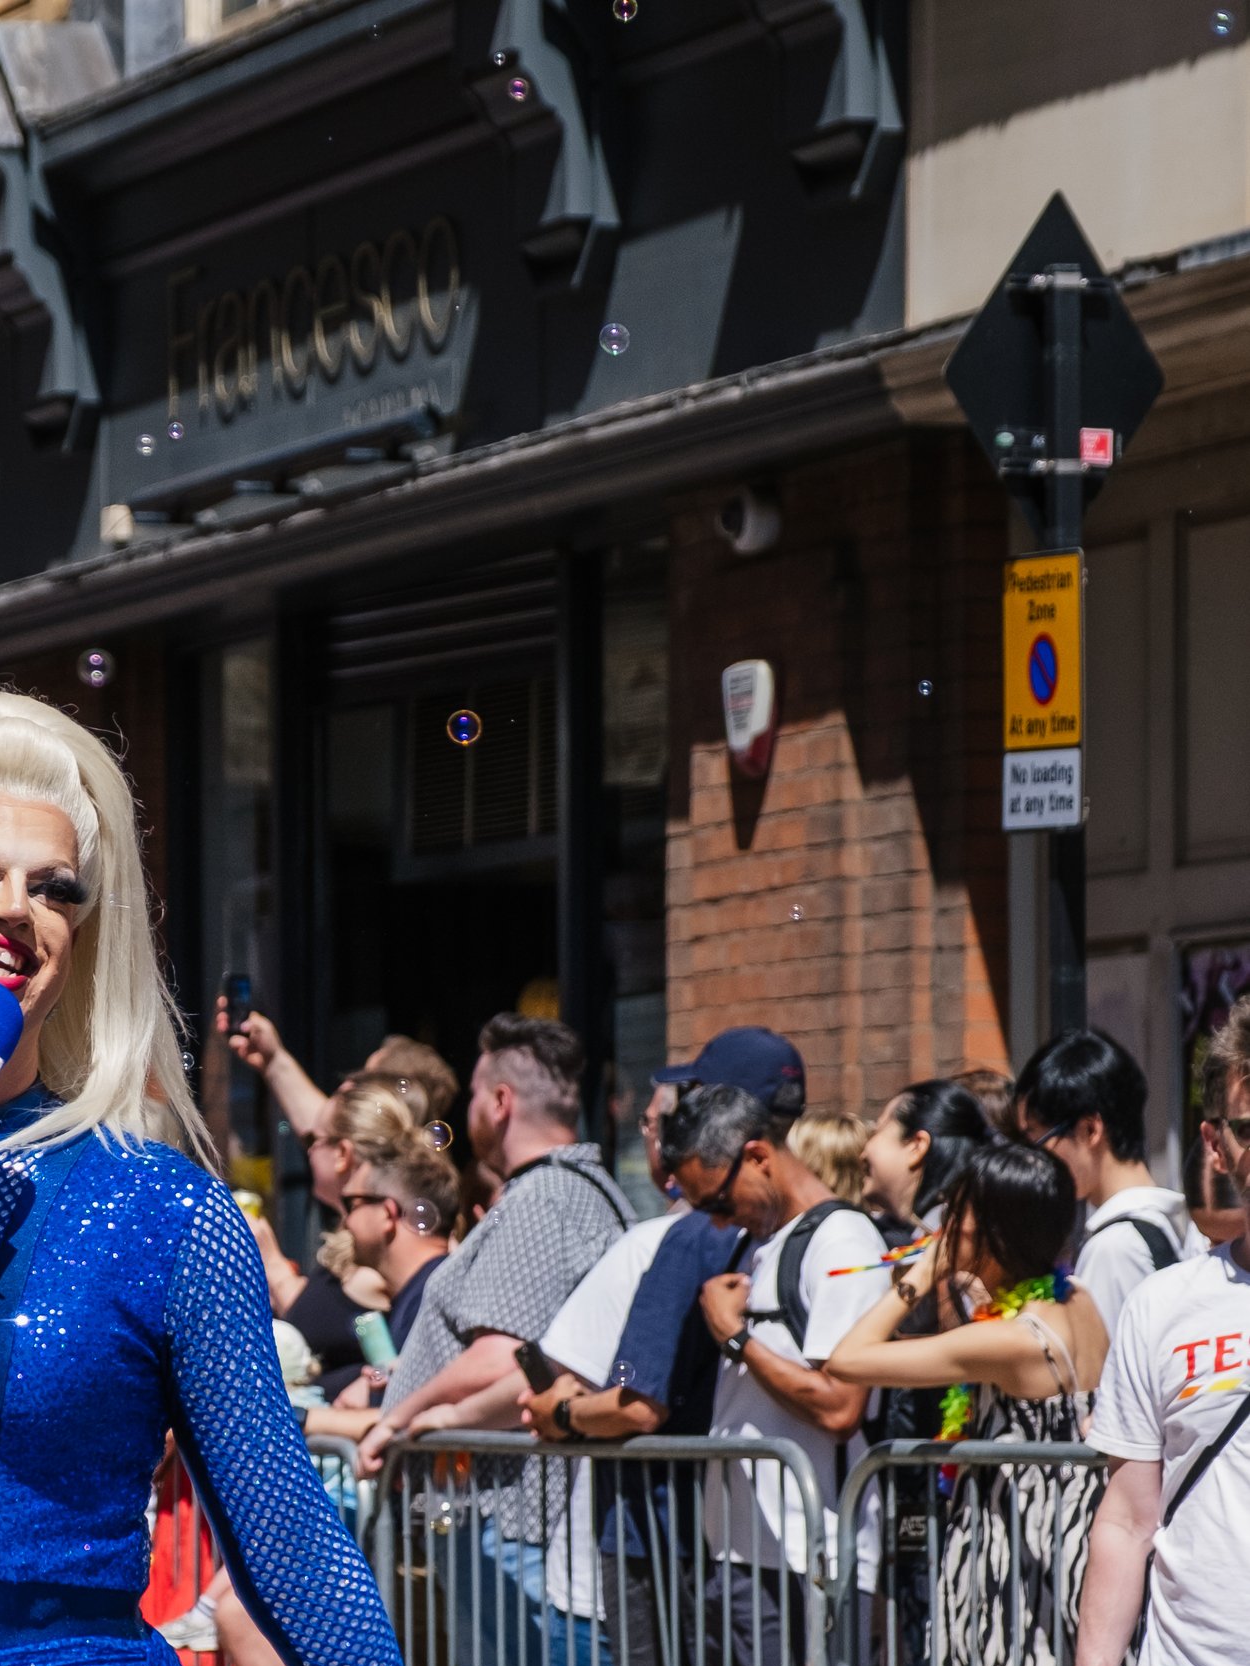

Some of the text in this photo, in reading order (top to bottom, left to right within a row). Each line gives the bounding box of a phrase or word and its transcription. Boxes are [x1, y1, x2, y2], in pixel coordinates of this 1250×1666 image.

[167, 215, 462, 422] Francesco
[1011, 570, 1073, 593] Pedestrian
[1028, 599, 1056, 622] Zone
[1010, 711, 1076, 738] At any time
[1010, 760, 1074, 785] No loading
[1009, 790, 1074, 817] at any time
[1172, 1332, 1250, 1380] TE
